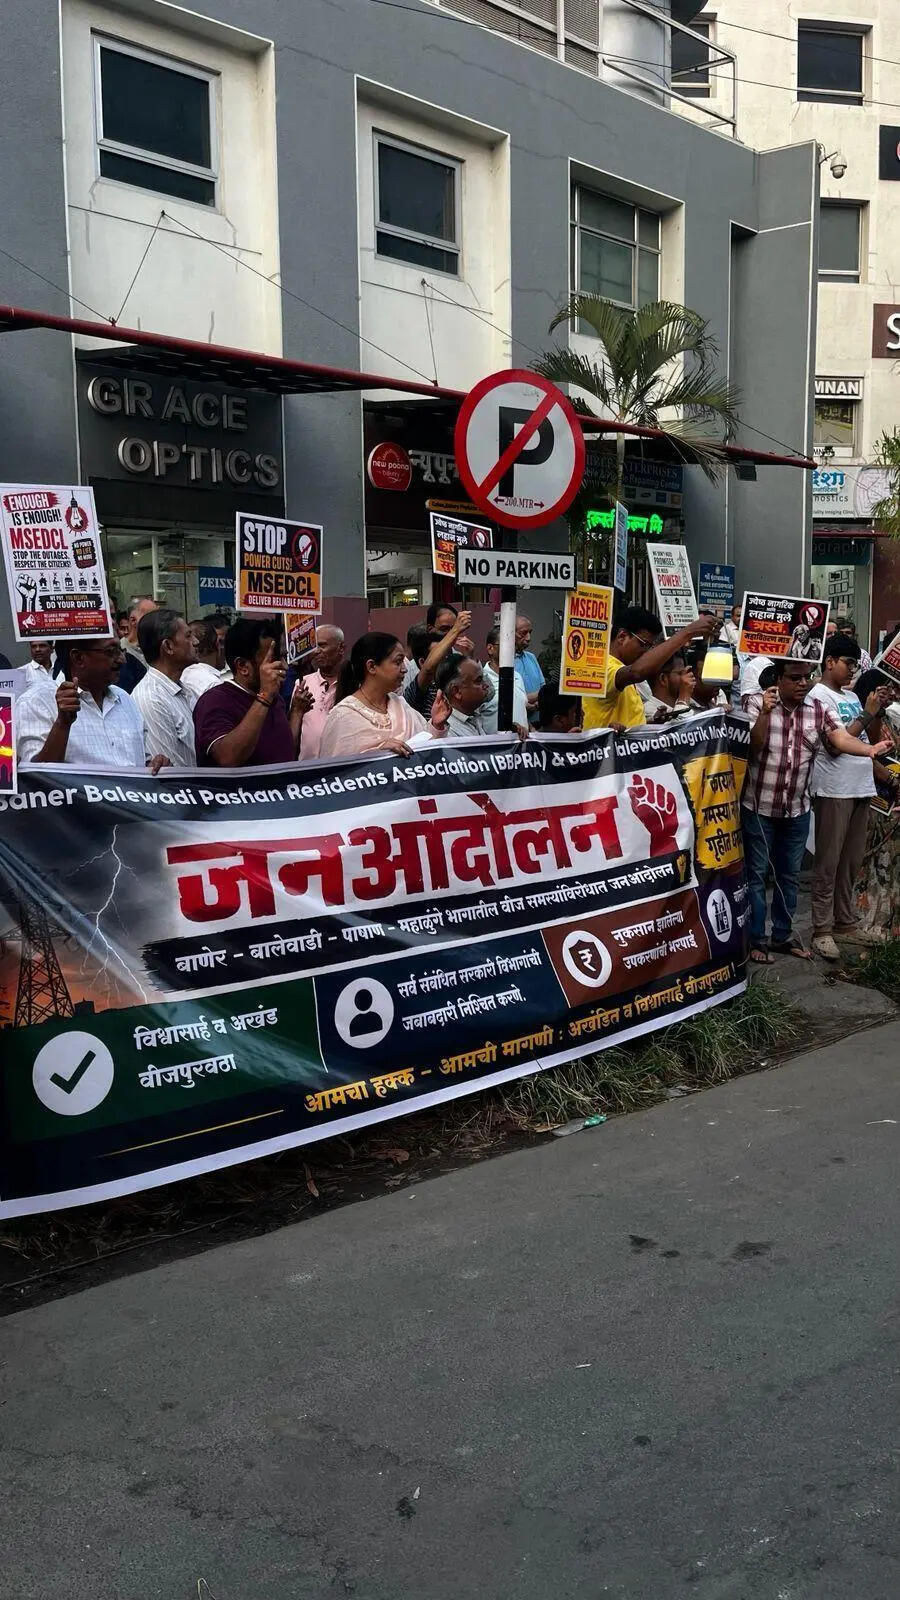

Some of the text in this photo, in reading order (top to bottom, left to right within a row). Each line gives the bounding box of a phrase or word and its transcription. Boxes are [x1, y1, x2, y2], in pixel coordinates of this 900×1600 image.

[87, 376, 248, 431] GRACE
[117, 437, 280, 487] OPTICS
[372, 460, 387, 468] new
[8, 493, 50, 511] ENOUGH
[12, 509, 62, 526] IS ENOUGH!
[9, 528, 68, 550] MSEDCL
[244, 521, 287, 555] STOP
[13, 551, 29, 560] STOP
[30, 551, 41, 560] THE
[14, 561, 36, 569] RESPECT
[37, 561, 47, 569] THE
[244, 553, 293, 571] POWER CUTS!
[465, 558, 571, 581] NO PARKING
[200, 577, 233, 589] ZEISS
[247, 571, 315, 597] MSEDCL
[46, 601, 55, 609] DO
[57, 601, 75, 609] YOUR
[248, 595, 316, 609] DELIVER RELIABLE POWER!
[570, 596, 608, 620] MSEDCL
[749, 610, 792, 623] लहान मुले
[84, 784, 197, 805] Balewadi
[199, 787, 284, 805] Pashan
[286, 772, 388, 800] Residents
[392, 755, 489, 783] Association
[492, 750, 546, 774] (BBPRA)
[551, 752, 565, 767] &
[566, 745, 611, 765] Baner
[615, 735, 671, 757] alewadi
[670, 726, 709, 749] Nagrik
[166, 793, 622, 924] जनआंदोलन
[175, 946, 227, 973] बाणेर
[249, 928, 322, 960] बालेवाडी
[342, 923, 386, 943] पाषाण
[398, 903, 444, 935] महाळुंगे
[446, 896, 499, 925] भागातील
[500, 896, 525, 914] वीज
[527, 880, 608, 911] समस्यांविरोधात
[609, 862, 674, 891] जनआंदोलन
[611, 920, 655, 947] नुकसान
[669, 929, 698, 953] भरपाई
[397, 948, 542, 998] सर्व संबंधित सरकारी विभागांची
[212, 1018, 227, 1034] व
[230, 1004, 278, 1031] अखंड
[402, 984, 527, 1031] जबाबदारी निश्चित करणे.
[303, 1080, 369, 1112] आमचा
[370, 1067, 415, 1098] हक्क
[439, 1040, 497, 1075] आमची
[502, 1025, 554, 1056] मागणी
[567, 1007, 620, 1037] अखंडित
[623, 1004, 633, 1018] व
[684, 965, 731, 995] वीजपुरवठा
[138, 1053, 237, 1089] वीजपुरवठा
